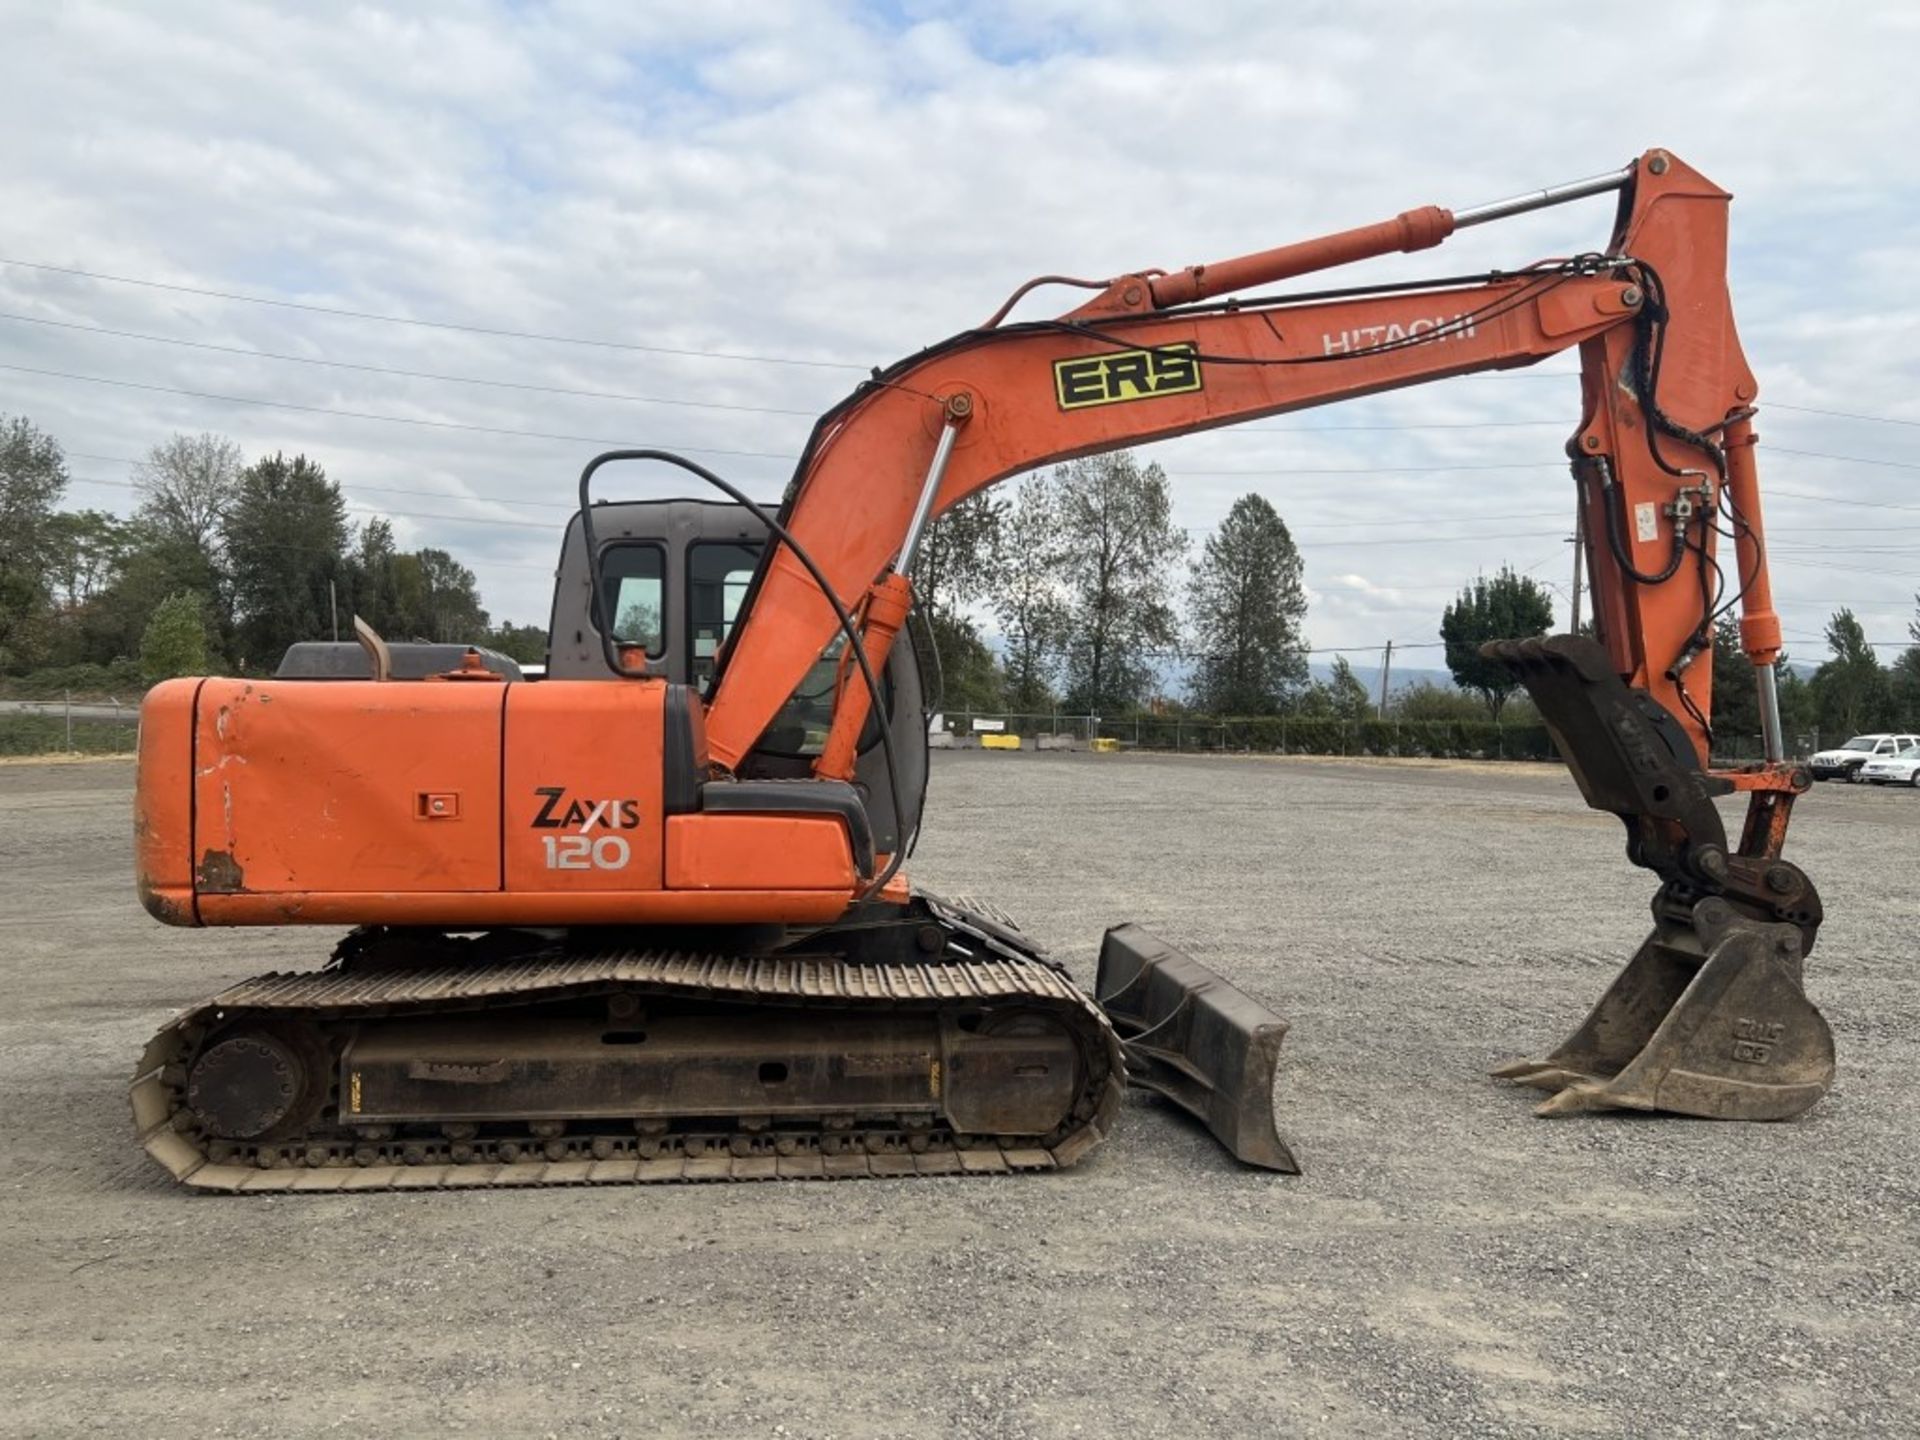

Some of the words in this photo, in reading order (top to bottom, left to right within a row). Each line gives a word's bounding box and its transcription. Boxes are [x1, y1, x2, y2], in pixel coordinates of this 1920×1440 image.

[1323, 312, 1475, 356] HITACHI
[1058, 345, 1196, 404] ERS
[531, 787, 640, 833] ZAXIS
[542, 836, 631, 870] 120
